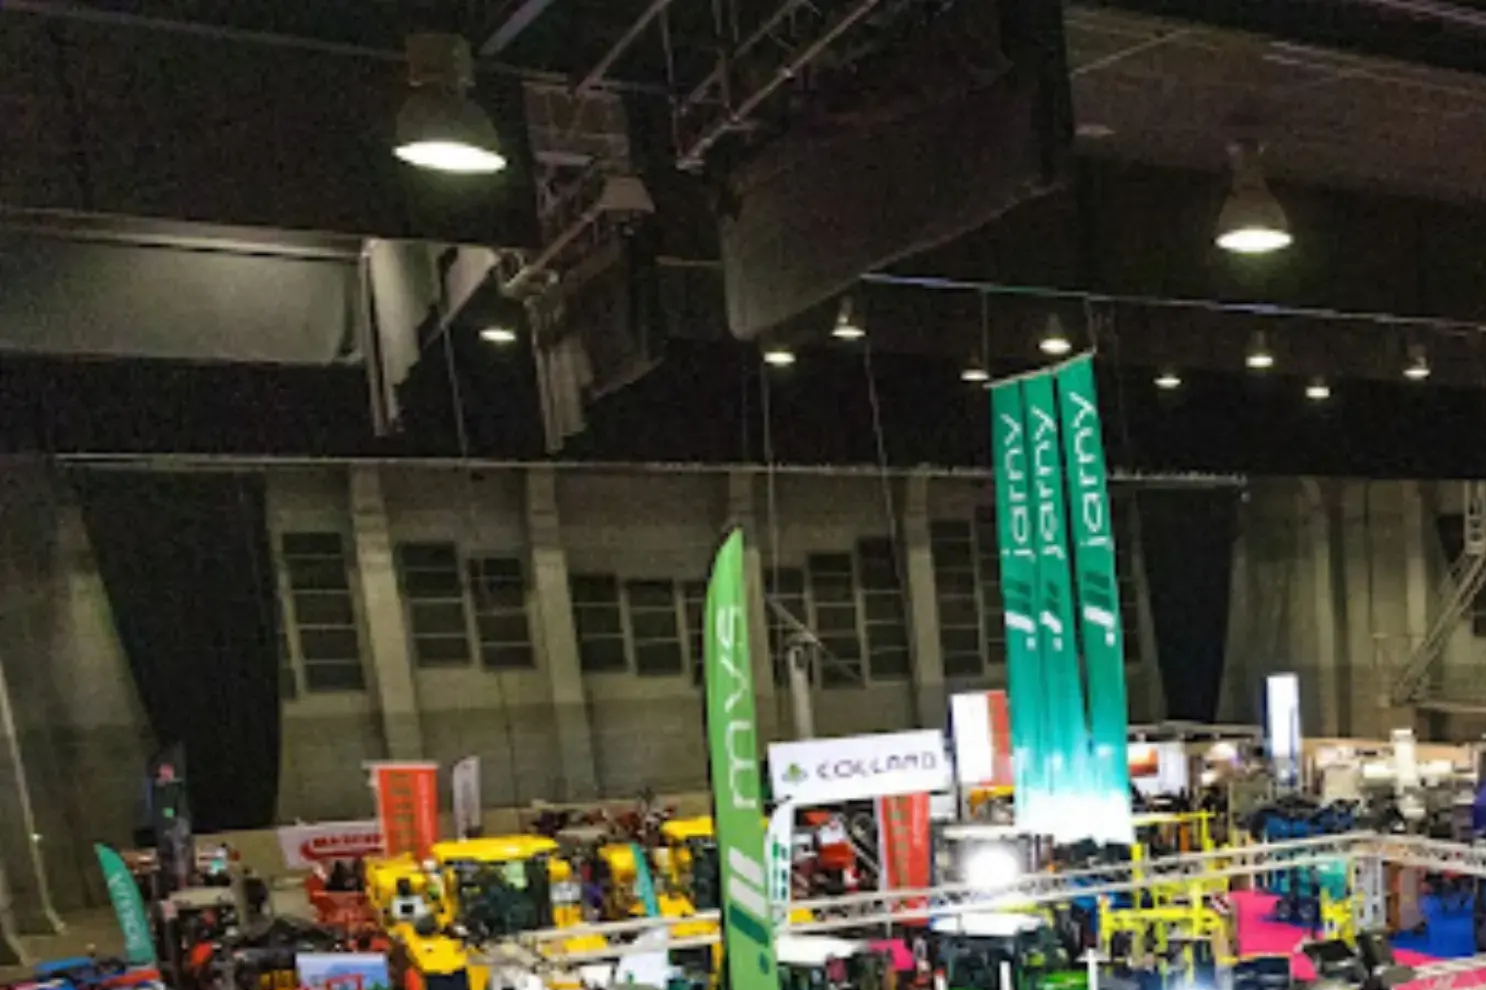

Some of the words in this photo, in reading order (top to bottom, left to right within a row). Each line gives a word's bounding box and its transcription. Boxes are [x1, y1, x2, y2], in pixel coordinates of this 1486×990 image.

[1000, 413, 1036, 562] jarny
[1030, 405, 1065, 559] jarny
[1069, 391, 1114, 549] jarny
[716, 606, 757, 809] mvs
